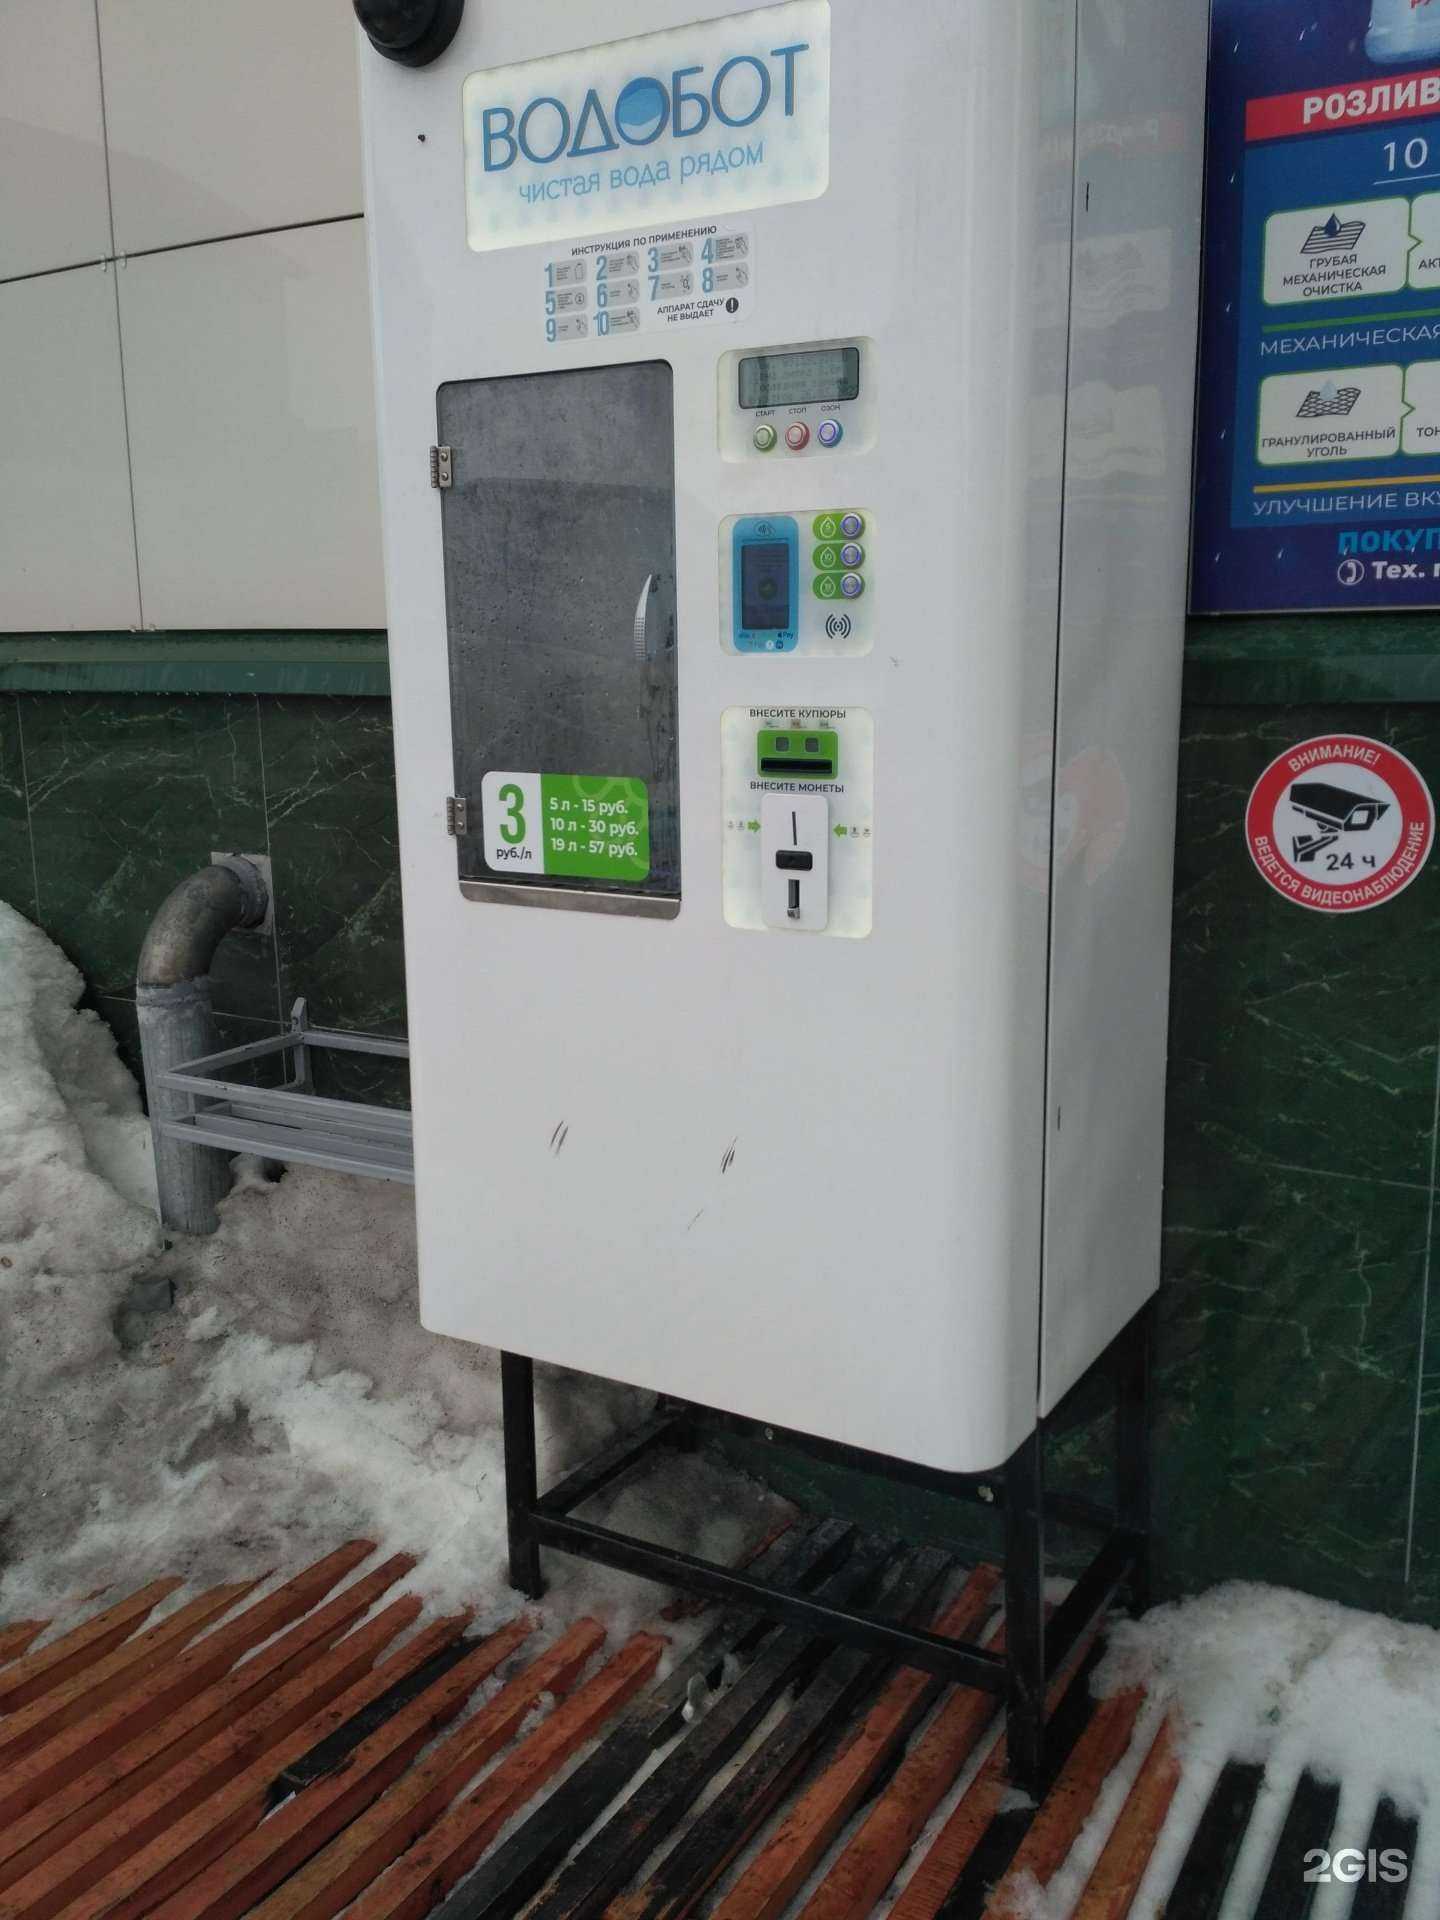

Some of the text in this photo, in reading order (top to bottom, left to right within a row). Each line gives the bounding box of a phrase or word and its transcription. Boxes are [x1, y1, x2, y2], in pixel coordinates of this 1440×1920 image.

[482, 43, 809, 172] ВОДОБОТ
[1303, 77, 1440, 124] РОЗЛИВ
[1384, 137, 1428, 172] 10
[519, 141, 764, 204] чистая вода рядом
[571, 226, 717, 256] ИНСТРУКЦИЯ ПО ПРИМЕНЕНИЮ
[701, 238, 714, 264] 4
[596, 255, 608, 281] 2
[648, 247, 658, 272] 3
[1310, 254, 1357, 269] ГРУБАЯ
[544, 263, 553, 288] 1
[702, 267, 713, 293] 8
[1283, 264, 1386, 286] МЕХАНИЧЕСКАЯ
[597, 283, 608, 308] 6
[648, 275, 660, 301] 7
[1303, 281, 1362, 297] ОЧИСТКА
[545, 290, 556, 315] 5
[657, 298, 724, 314] АППАРАТ СДАЧУ
[593, 310, 609, 336] 10
[667, 309, 714, 322] НЕ ВЫДАЕТ
[546, 318, 556, 342] 9
[1261, 323, 1440, 356] МЕХАНИЧЕСКАЯ
[755, 409, 776, 417] СТАРТ
[788, 407, 807, 415] СТОП
[1262, 425, 1396, 448] ГРАНУЛИРОВАННЫЙ
[1306, 445, 1348, 458] УГОЛЬ
[1253, 492, 1398, 516] УЛУЧШЕНИЕ
[1372, 561, 1425, 579] Тех.
[750, 709, 846, 719] ВНЕСИТЕ КУПЮРЫ
[1288, 743, 1381, 772] ВНИМАНИЕ!
[750, 781, 844, 793] ВНЕСИТЕ МОНЕТЫ
[498, 784, 526, 844] 3
[550, 798, 558, 810] 5
[561, 802, 570, 811] л
[582, 799, 596, 812] 15
[599, 800, 628, 816] руб.
[550, 818, 564, 831] 10
[568, 822, 577, 831] л
[589, 820, 606, 833] 30
[609, 821, 639, 837] руб.
[496, 847, 532, 860] руб./л
[551, 838, 565, 851] 19
[568, 841, 577, 851] л
[589, 840, 605, 854] 57
[608, 842, 638, 858] руб.
[1255, 822, 1425, 905] ВЕДЕТСЯ ВИДЕОНАБЛЮДЕНИЕ
[1326, 852, 1354, 871] 24
